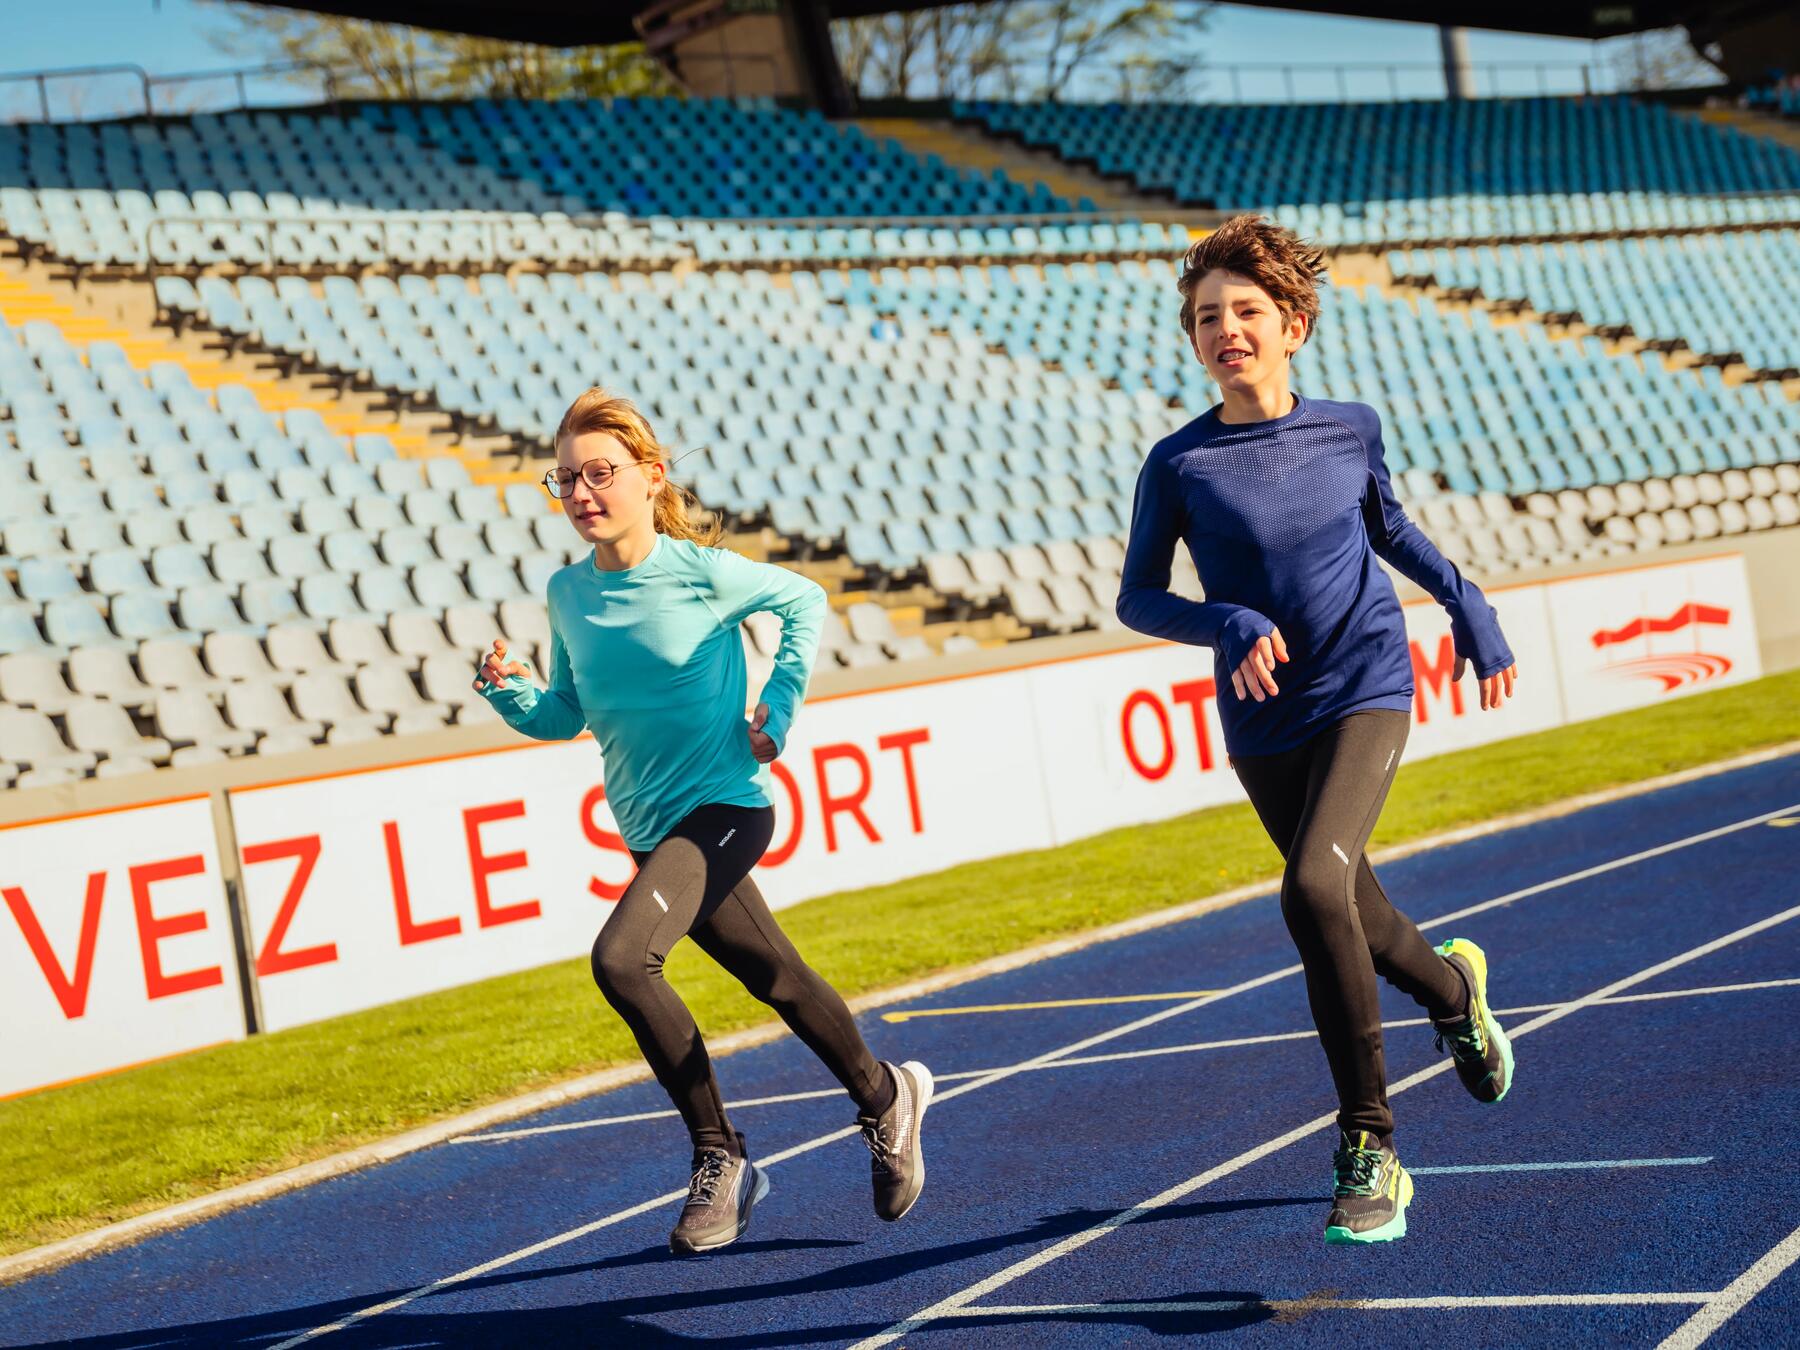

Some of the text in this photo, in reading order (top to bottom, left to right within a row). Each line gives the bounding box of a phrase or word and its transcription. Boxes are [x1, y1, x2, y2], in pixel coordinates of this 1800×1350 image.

[1, 833, 339, 1020] VEZ
[382, 799, 542, 946] LE
[579, 727, 931, 902] SORT
